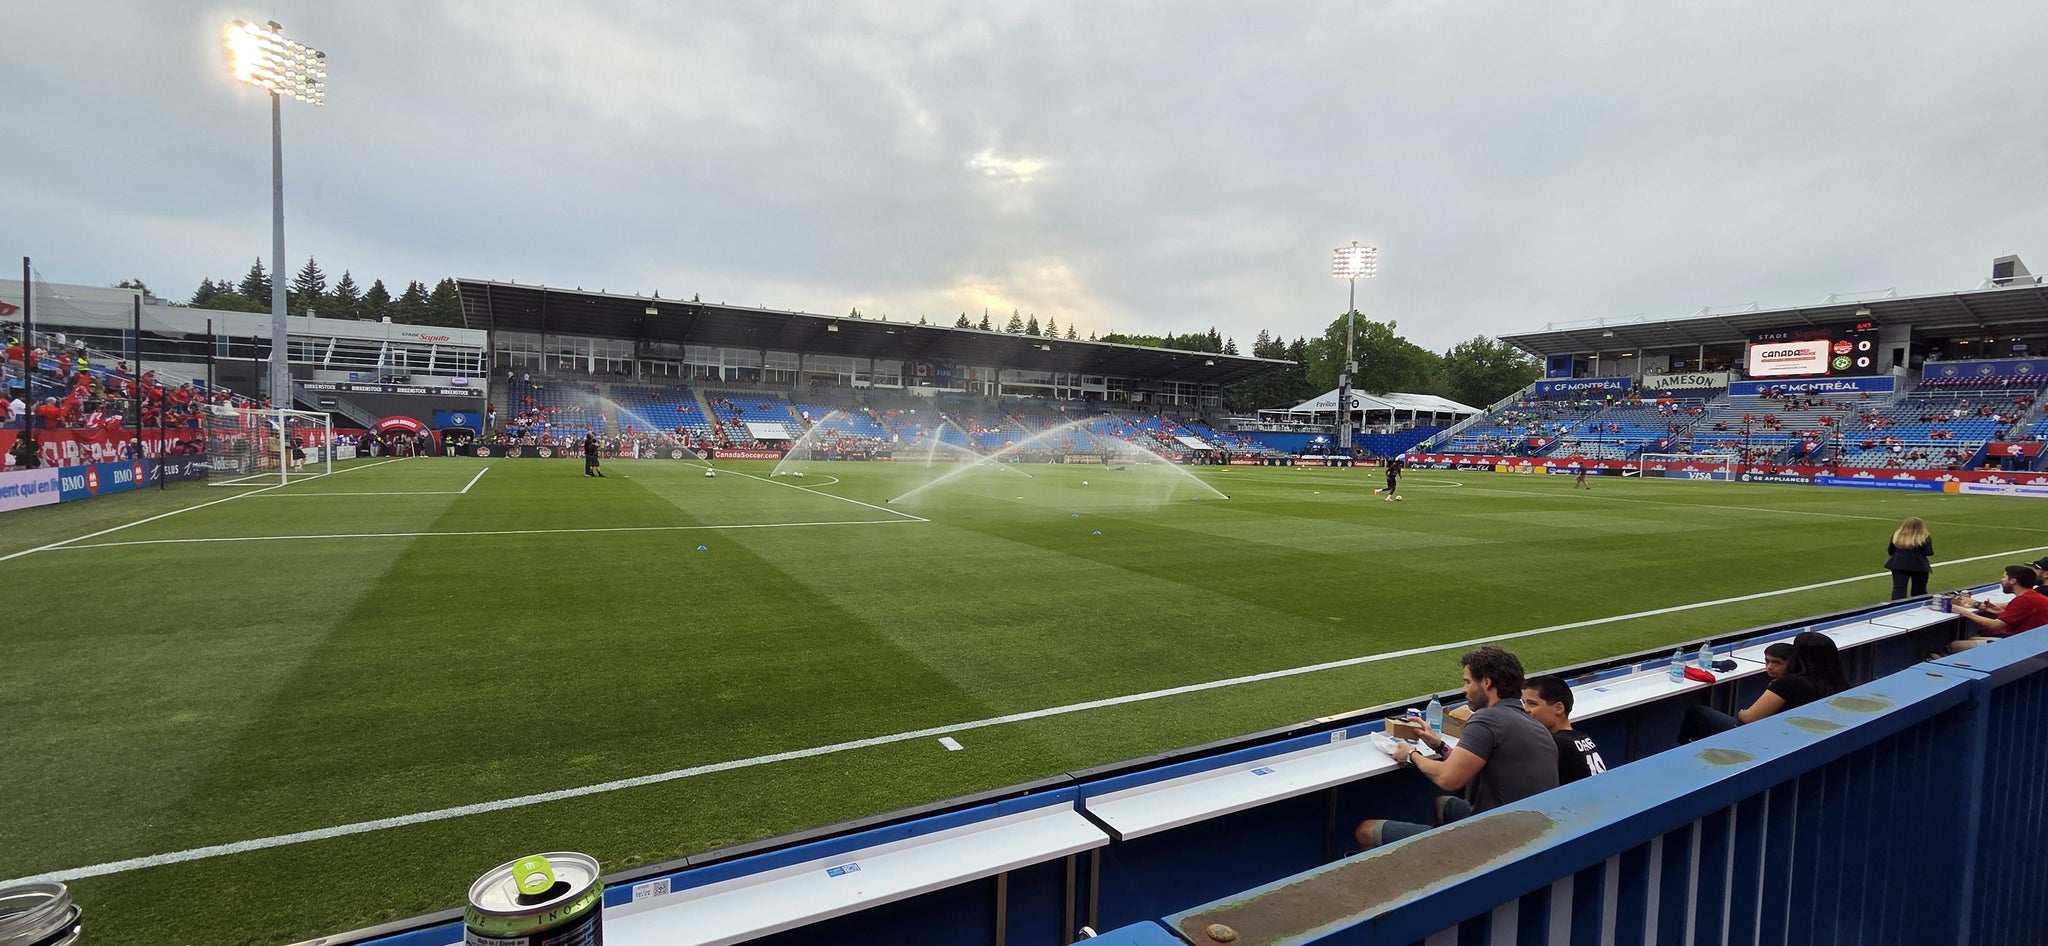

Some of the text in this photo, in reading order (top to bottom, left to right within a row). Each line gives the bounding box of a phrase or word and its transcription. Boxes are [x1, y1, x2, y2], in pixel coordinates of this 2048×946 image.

[419, 333, 450, 342] Saputo
[1758, 332, 1788, 340] STADE
[1858, 340, 1872, 352] 0
[1761, 349, 1801, 359] CANADA
[1857, 356, 1870, 368] 0
[1554, 380, 1621, 391] CF MONTRÉAL
[1656, 375, 1715, 388] JAMESON
[1788, 380, 1860, 392] MONTRÉAL
[714, 451, 779, 459] CanadaSoccer.com
[113, 468, 133, 484] BMO
[164, 464, 179, 476] ELUS
[1688, 471, 1712, 480] VISA
[21, 479, 37, 498] qui
[38, 480, 50, 493] en
[61, 475, 85, 492] BMO
[537, 880, 605, 925] INOSITO
